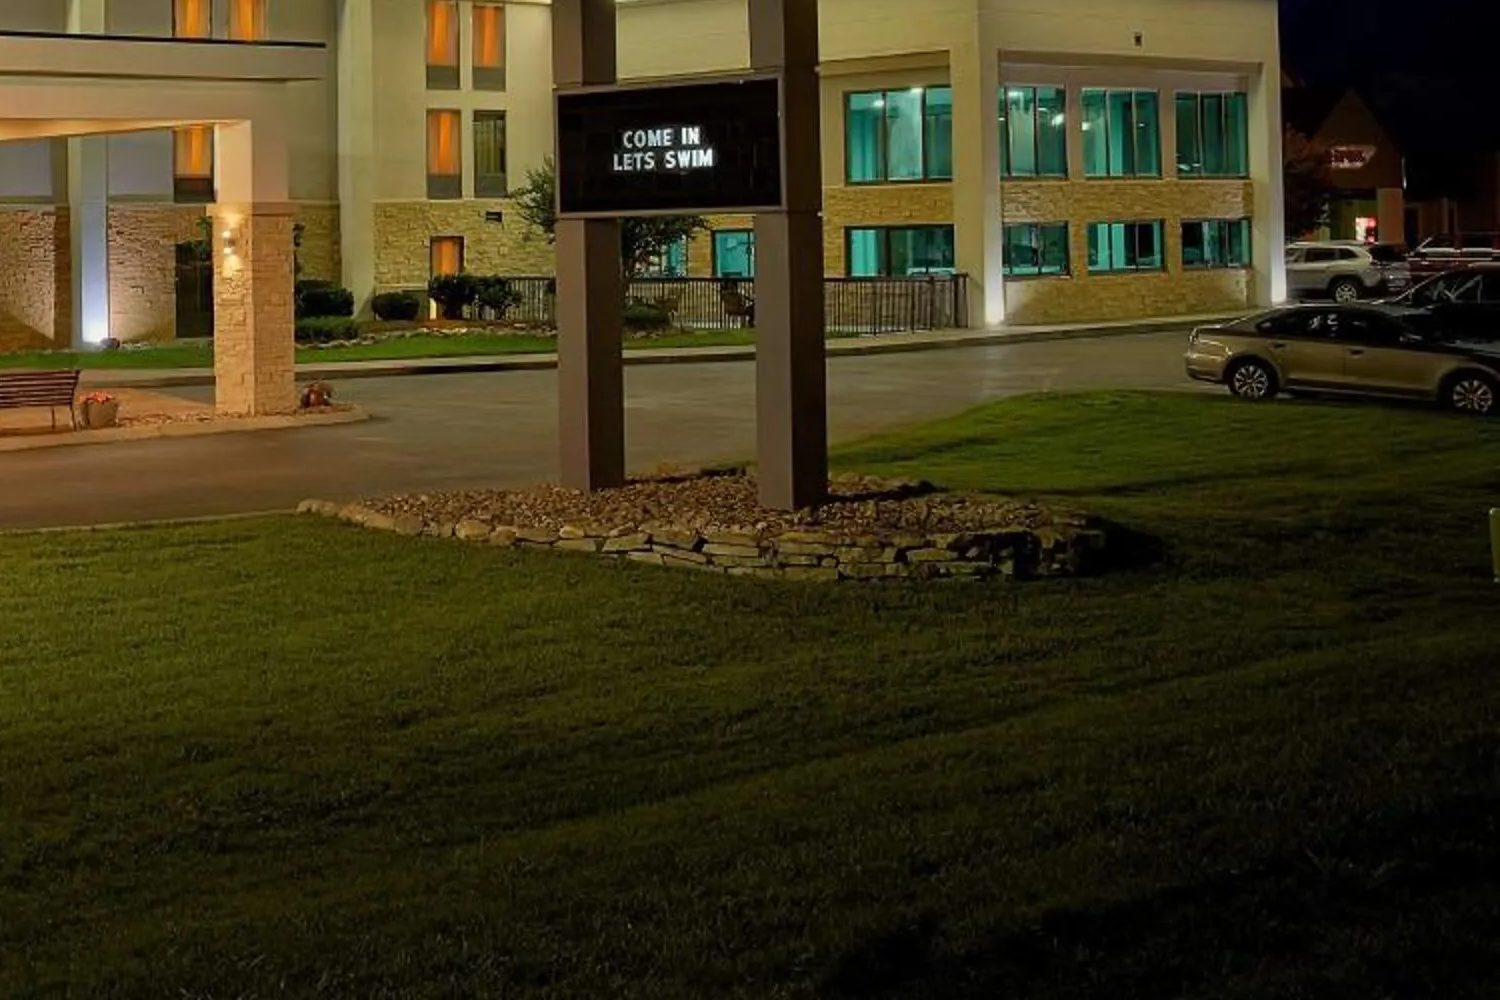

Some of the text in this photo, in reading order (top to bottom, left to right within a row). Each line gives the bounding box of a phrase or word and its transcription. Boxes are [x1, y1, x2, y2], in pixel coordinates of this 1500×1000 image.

[623, 127, 700, 148] COME IN
[613, 148, 713, 171] LETS SWIM
